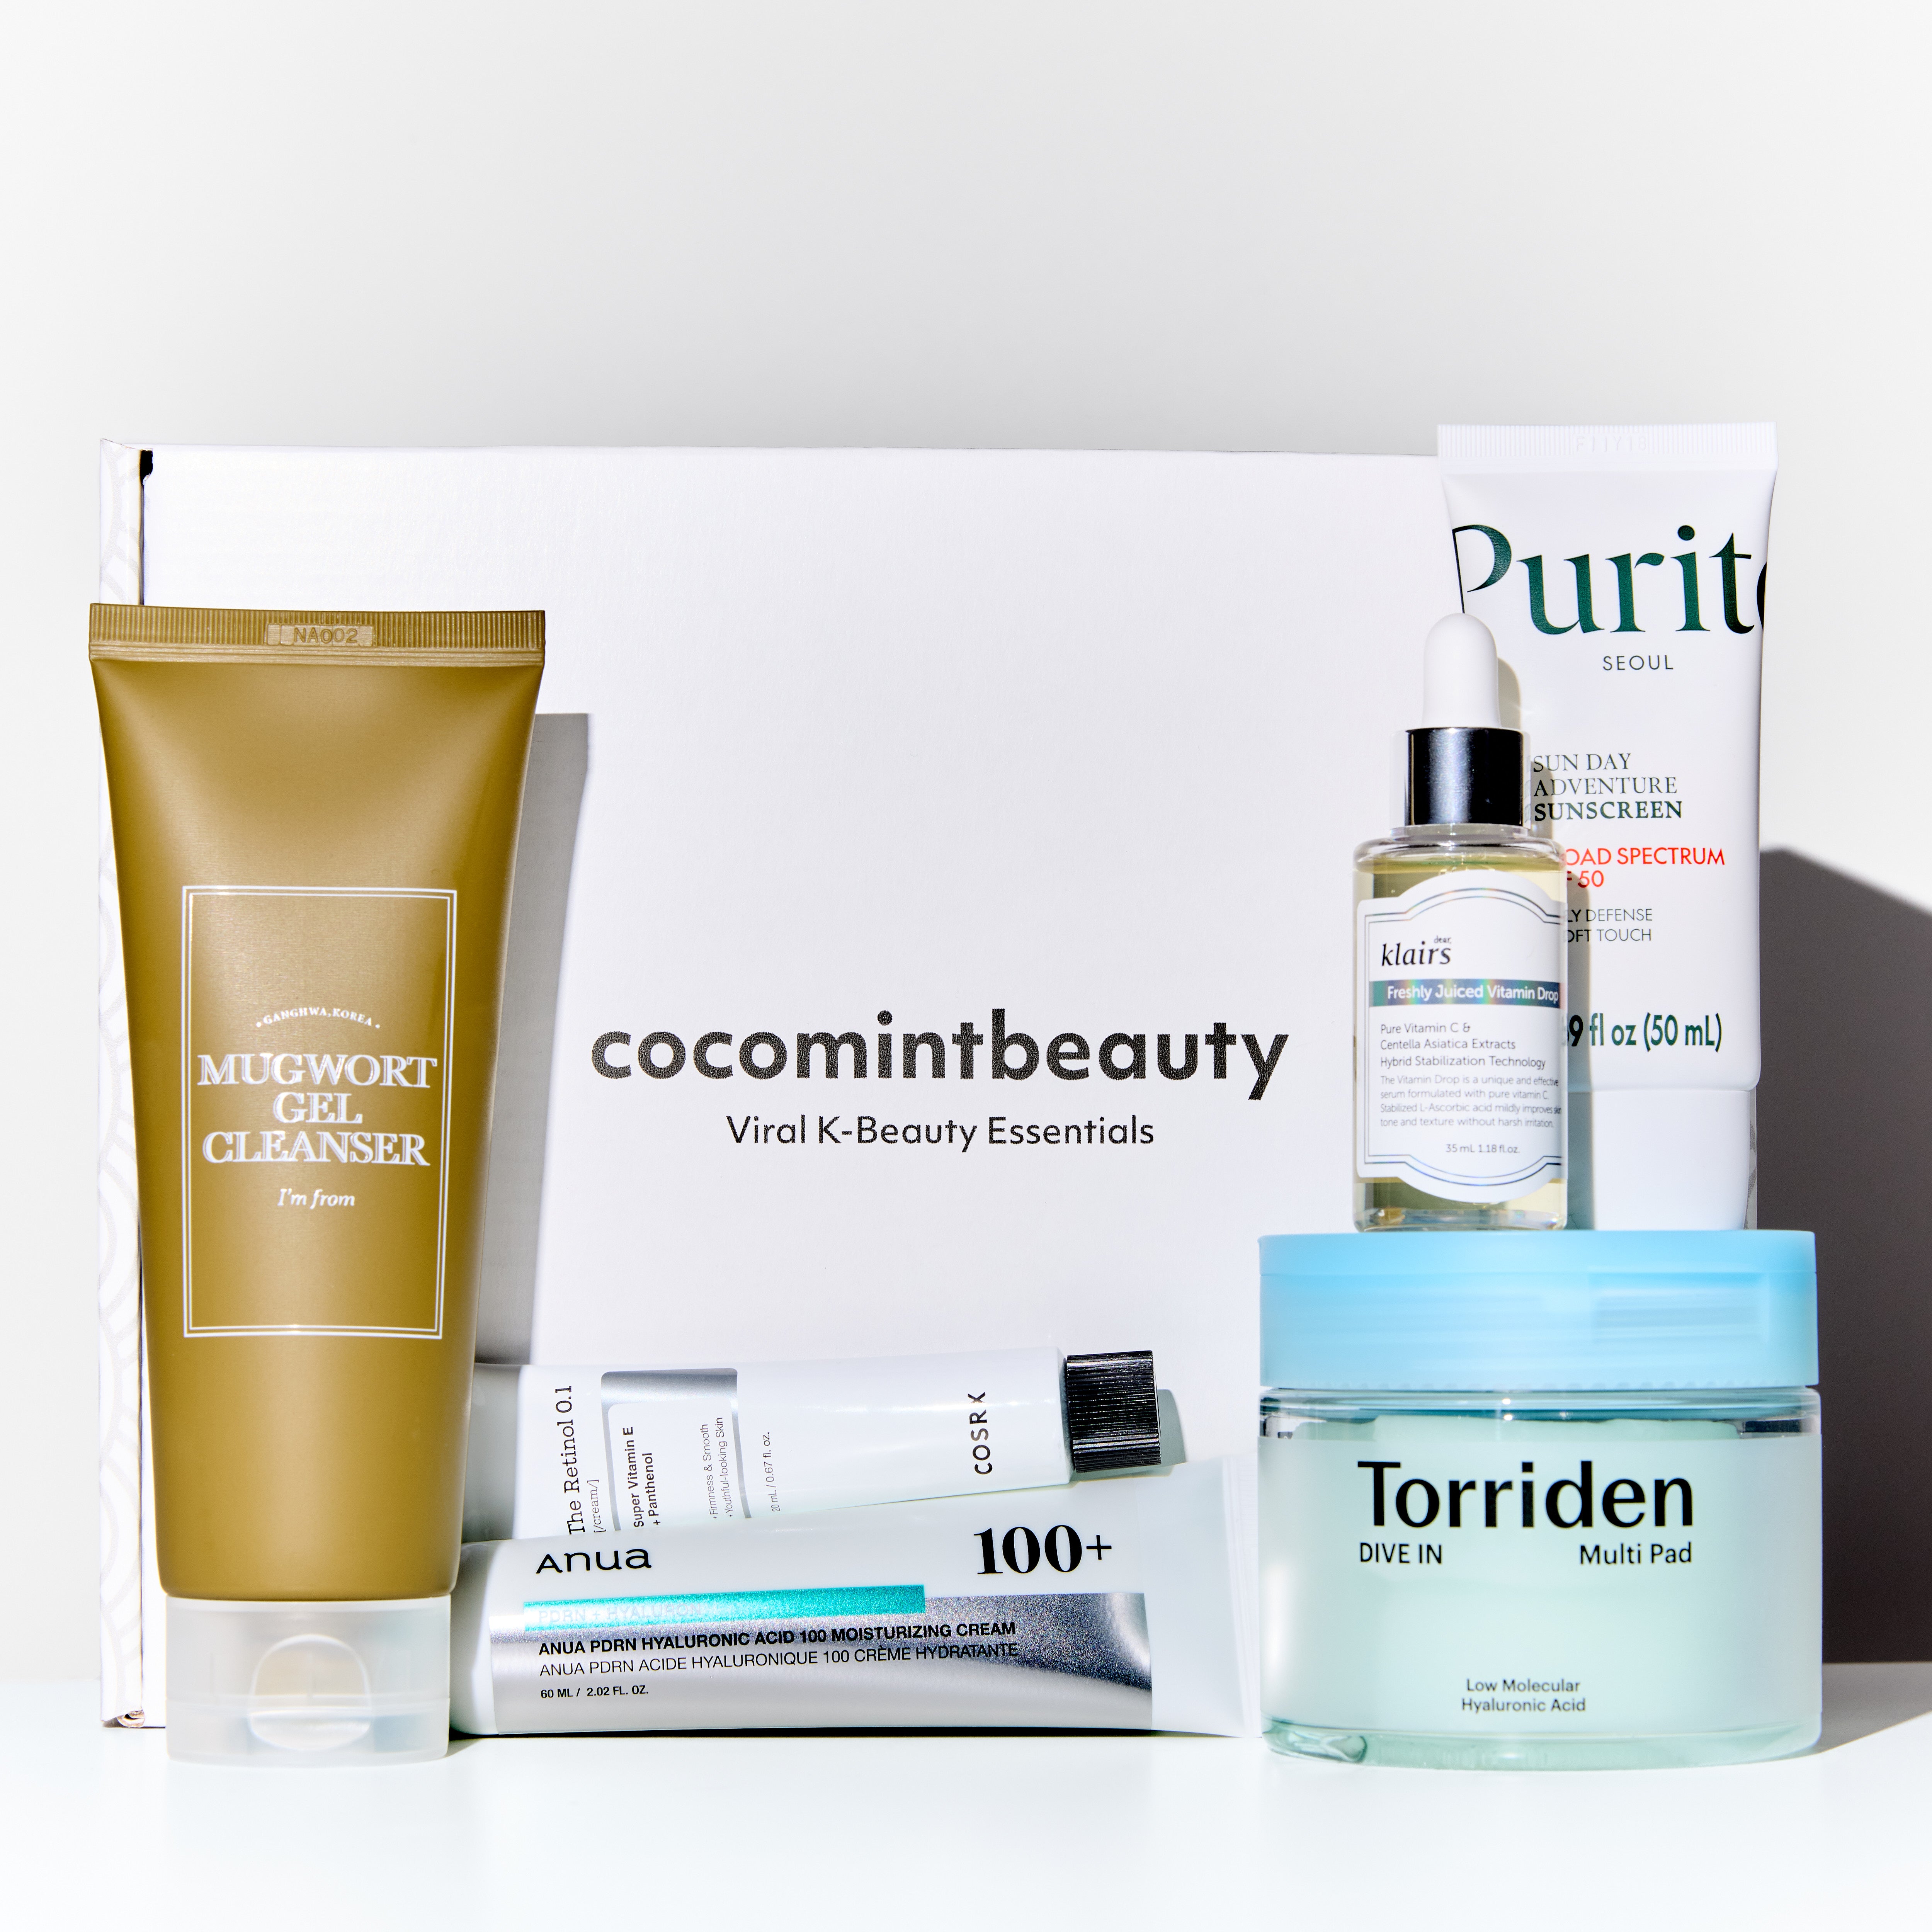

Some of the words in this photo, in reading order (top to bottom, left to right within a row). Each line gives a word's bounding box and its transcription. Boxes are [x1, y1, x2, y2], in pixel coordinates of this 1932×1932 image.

[1452, 524, 1767, 635] Purit
[1602, 655, 1674, 671] SEOUL
[1533, 754, 1578, 772] SUN
[1587, 753, 1631, 770] DAY
[1533, 777, 1677, 796] ADVENTURE
[1534, 801, 1682, 821] SUNSCREEN
[1566, 848, 1612, 866] OAD
[1617, 847, 1725, 865] SPECTRUM
[1578, 870, 1604, 888] 50
[1586, 908, 1653, 922] DEFENSE
[1434, 935, 1452, 944] dear,
[1567, 929, 1592, 942] OFT
[1597, 929, 1651, 942] TOUCH
[1381, 940, 1451, 966] klairs
[1387, 985, 1433, 1001] Freshly
[1435, 984, 1484, 998] Juiced
[1487, 985, 1535, 1000] Vitamin
[1537, 986, 1559, 1004] Drop
[1381, 1024, 1401, 1034] Pure
[1404, 1023, 1446, 1033] Vitamin
[1450, 1022, 1459, 1032] C
[1463, 1022, 1470, 1032] &
[1590, 1013, 1604, 1046] fl
[1611, 1024, 1636, 1046] oz
[1644, 1012, 1678, 1052] (50
[1685, 1013, 1722, 1053] mL)
[591, 1007, 1289, 1100] cocomintbeauty
[1381, 1039, 1420, 1051] Centella
[1423, 1039, 1468, 1049] Asiatica
[1472, 1039, 1516, 1050] Extracts
[197, 1053, 437, 1088] MUGWORT
[1381, 1056, 1412, 1070] Hybrid
[1415, 1056, 1485, 1066] Stabilization
[1489, 1056, 1546, 1070] Technology
[1381, 1075, 1395, 1084] The
[1397, 1075, 1431, 1084] Vitamin
[1435, 1075, 1459, 1085] Drop
[1463, 1075, 1470, 1083] is
[1482, 1075, 1514, 1086] unique
[1516, 1076, 1531, 1085] and
[1534, 1077, 1559, 1086] effective
[1408, 1089, 1461, 1098] formulated
[1464, 1089, 1486, 1098] with
[1489, 1091, 1510, 1099] pure
[1512, 1090, 1541, 1099] vitamin
[273, 1092, 362, 1124] GEL
[1381, 1104, 1417, 1113] Stabilized
[1420, 1103, 1470, 1112] L-Ascorbic
[1473, 1104, 1492, 1112] acid
[1495, 1104, 1520, 1114] mildly
[1523, 1104, 1553, 1115] improves
[1400, 1117, 1417, 1126] and
[1458, 1117, 1495, 1126] without
[1498, 1117, 1522, 1127] harsh
[1524, 1118, 1553, 1128] irritation.
[726, 1114, 806, 1145] Viral
[819, 1114, 978, 1153] K-Beauty
[988, 1115, 1154, 1145] Essentials
[202, 1131, 430, 1166] CLEANSER
[1446, 1144, 1458, 1152] 35
[1460, 1145, 1475, 1153] mL
[1479, 1145, 1497, 1153] 1.18
[277, 1188, 307, 1206] I'm
[310, 1189, 355, 1209] from
[555, 1385, 572, 1413] 0.1
[622, 1427, 634, 1436] E
[715, 1417, 725, 1438] Skin
[967, 1391, 993, 1475] COSRX
[700, 1423, 712, 1461] Smooth
[557, 1419, 580, 1494] Retinol
[762, 1450, 772, 1458] fl.
[624, 1440, 638, 1490] Vitamin
[764, 1461, 775, 1483] 0.67
[642, 1453, 659, 1517] Panthenol
[718, 1441, 733, 1514] Youthful-looking
[706, 1475, 718, 1515] Firmness
[768, 1490, 777, 1502] mL
[1357, 1461, 1692, 1528] Torriden
[567, 1500, 586, 1535] The
[631, 1493, 645, 1528] Super
[973, 1524, 1112, 1575] 100+
[1359, 1543, 1410, 1563] DIVE
[1419, 1544, 1442, 1564] IN
[1580, 1543, 1641, 1565] Multi
[1651, 1541, 1692, 1563] Pad
[536, 1548, 652, 1574] Anua
[538, 1608, 586, 1624] PDRN
[539, 1641, 585, 1656] ANUA
[590, 1638, 636, 1653] PDRN
[642, 1632, 750, 1650] HYALURONIC
[754, 1630, 795, 1645] ACID
[800, 1629, 827, 1644] 100
[831, 1624, 952, 1642] MOISTURIZING
[956, 1622, 1016, 1637] CREAM
[540, 1662, 585, 1677] ANUA
[590, 1660, 634, 1674] PDRN
[639, 1657, 687, 1672] ACIDE
[692, 1651, 817, 1669] HYALURONIQUE
[824, 1650, 849, 1663] 100
[854, 1644, 911, 1662] CRÈME
[915, 1643, 1019, 1659] HYDRATANTE
[541, 1688, 554, 1699] 60
[557, 1688, 573, 1698] ML
[576, 1687, 580, 1697] /
[587, 1686, 610, 1697] 2.02
[613, 1685, 629, 1696] FL.
[632, 1685, 649, 1695] OZ.
[1466, 1679, 1497, 1692] Low
[1502, 1679, 1580, 1692] Molecular
[1462, 1697, 1546, 1713] Hyaluronic
[1551, 1697, 1585, 1712] Acid
